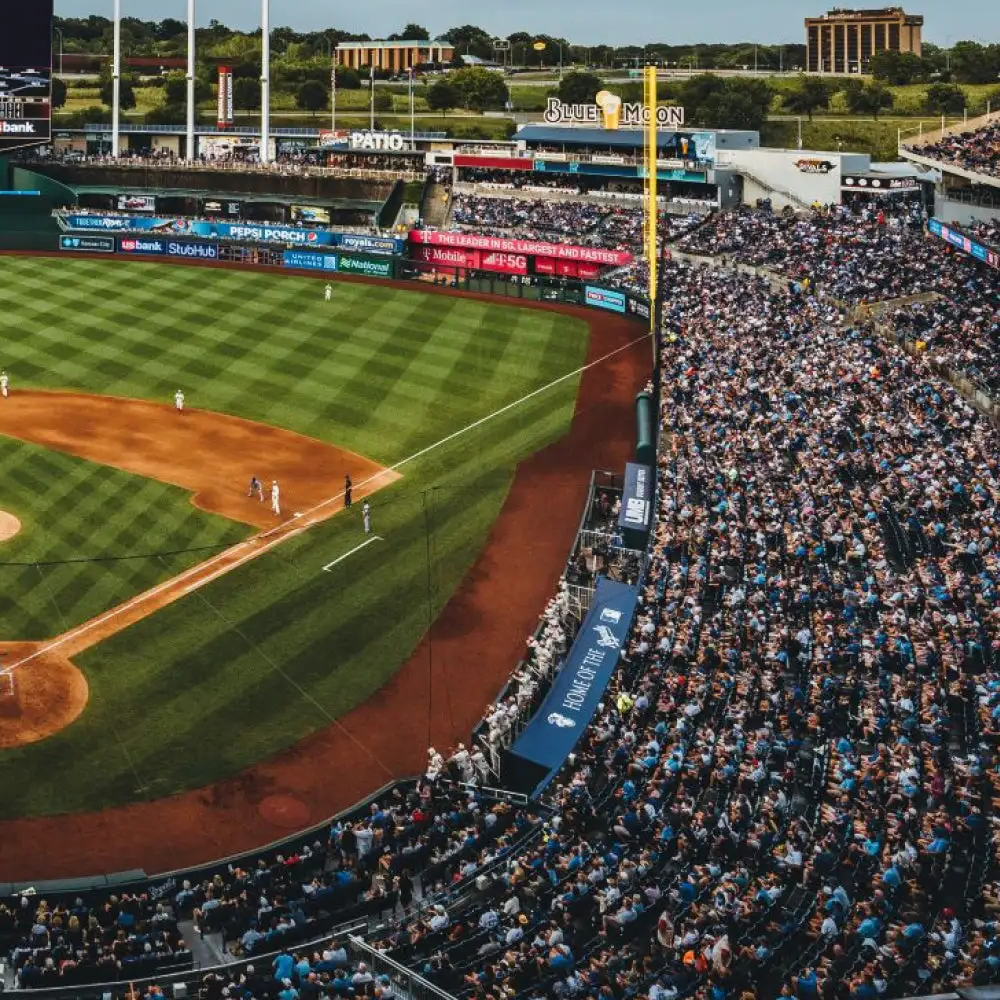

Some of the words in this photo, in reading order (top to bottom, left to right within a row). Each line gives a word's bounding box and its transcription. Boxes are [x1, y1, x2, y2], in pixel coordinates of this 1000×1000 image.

[545, 97, 597, 123] BLUE
[623, 102, 684, 124] MOON
[352, 132, 403, 150] PATIO
[230, 227, 262, 237] PEPSI
[265, 229, 305, 241] PORCH
[168, 242, 216, 258] StubHub
[345, 238, 394, 248] royals.com
[438, 234, 454, 244] THE
[457, 237, 489, 247] LEADER
[491, 240, 500, 248] IN
[518, 243, 556, 254] LARGEST
[559, 248, 579, 257] AND
[433, 249, 466, 262] Mobile
[508, 255, 526, 269] 5G
[351, 260, 389, 271] National
[625, 498, 645, 523] UMB
[563, 681, 589, 711] HOME
[584, 648, 605, 668] THE
